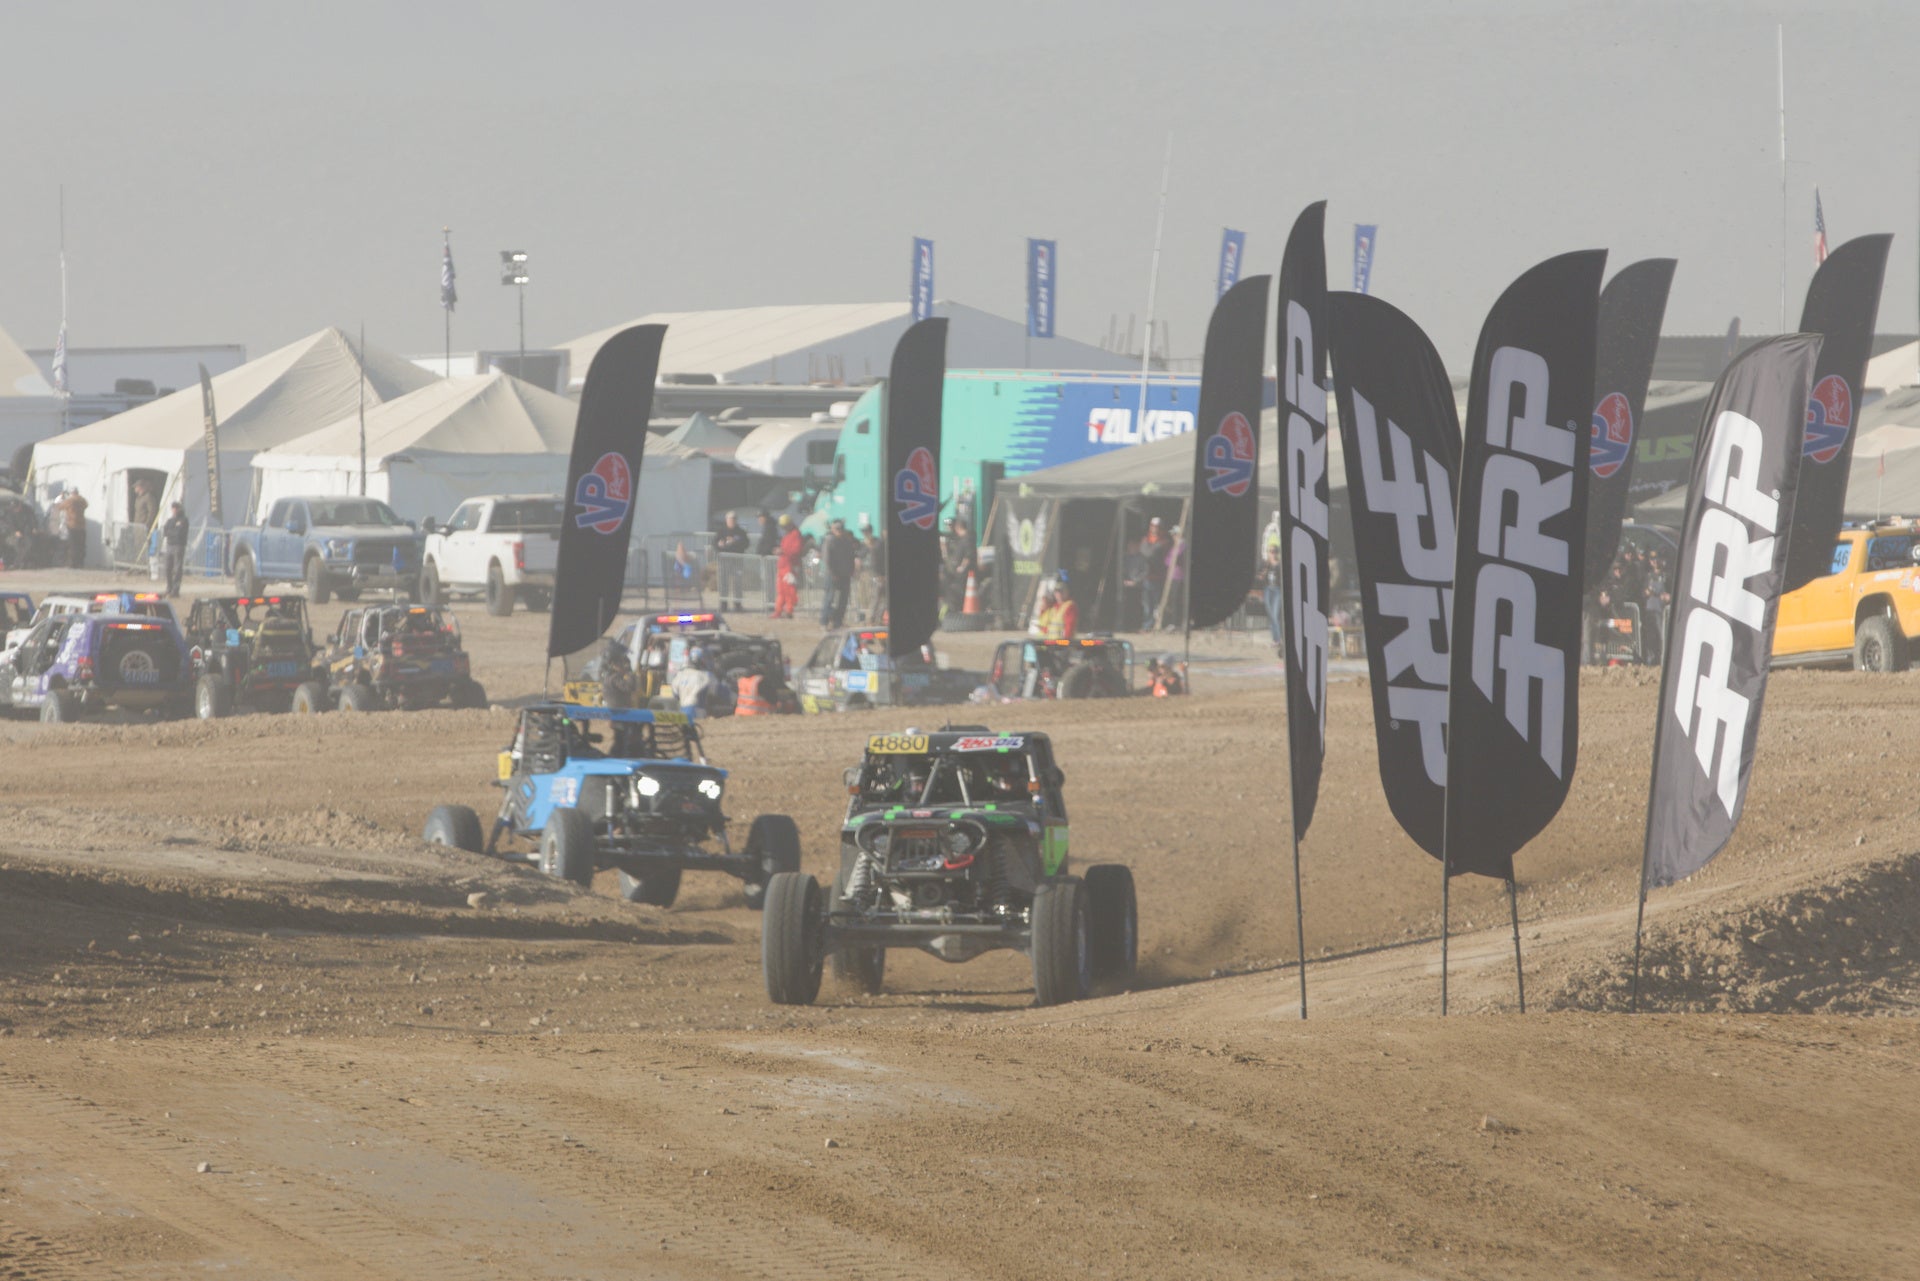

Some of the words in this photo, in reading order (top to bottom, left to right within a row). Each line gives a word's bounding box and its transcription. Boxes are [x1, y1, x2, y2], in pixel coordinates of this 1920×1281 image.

[1037, 245, 1050, 333] FALKEN
[1087, 407, 1195, 445] FALKEN
[1204, 434, 1255, 493] VP
[575, 472, 630, 529] VP
[895, 469, 937, 525] VP
[1285, 300, 1329, 755] PRP
[1472, 346, 1577, 781] PRP
[1674, 410, 1779, 820] PRP
[872, 736, 926, 751] 4880
[956, 736, 1023, 750] AMSOIL
